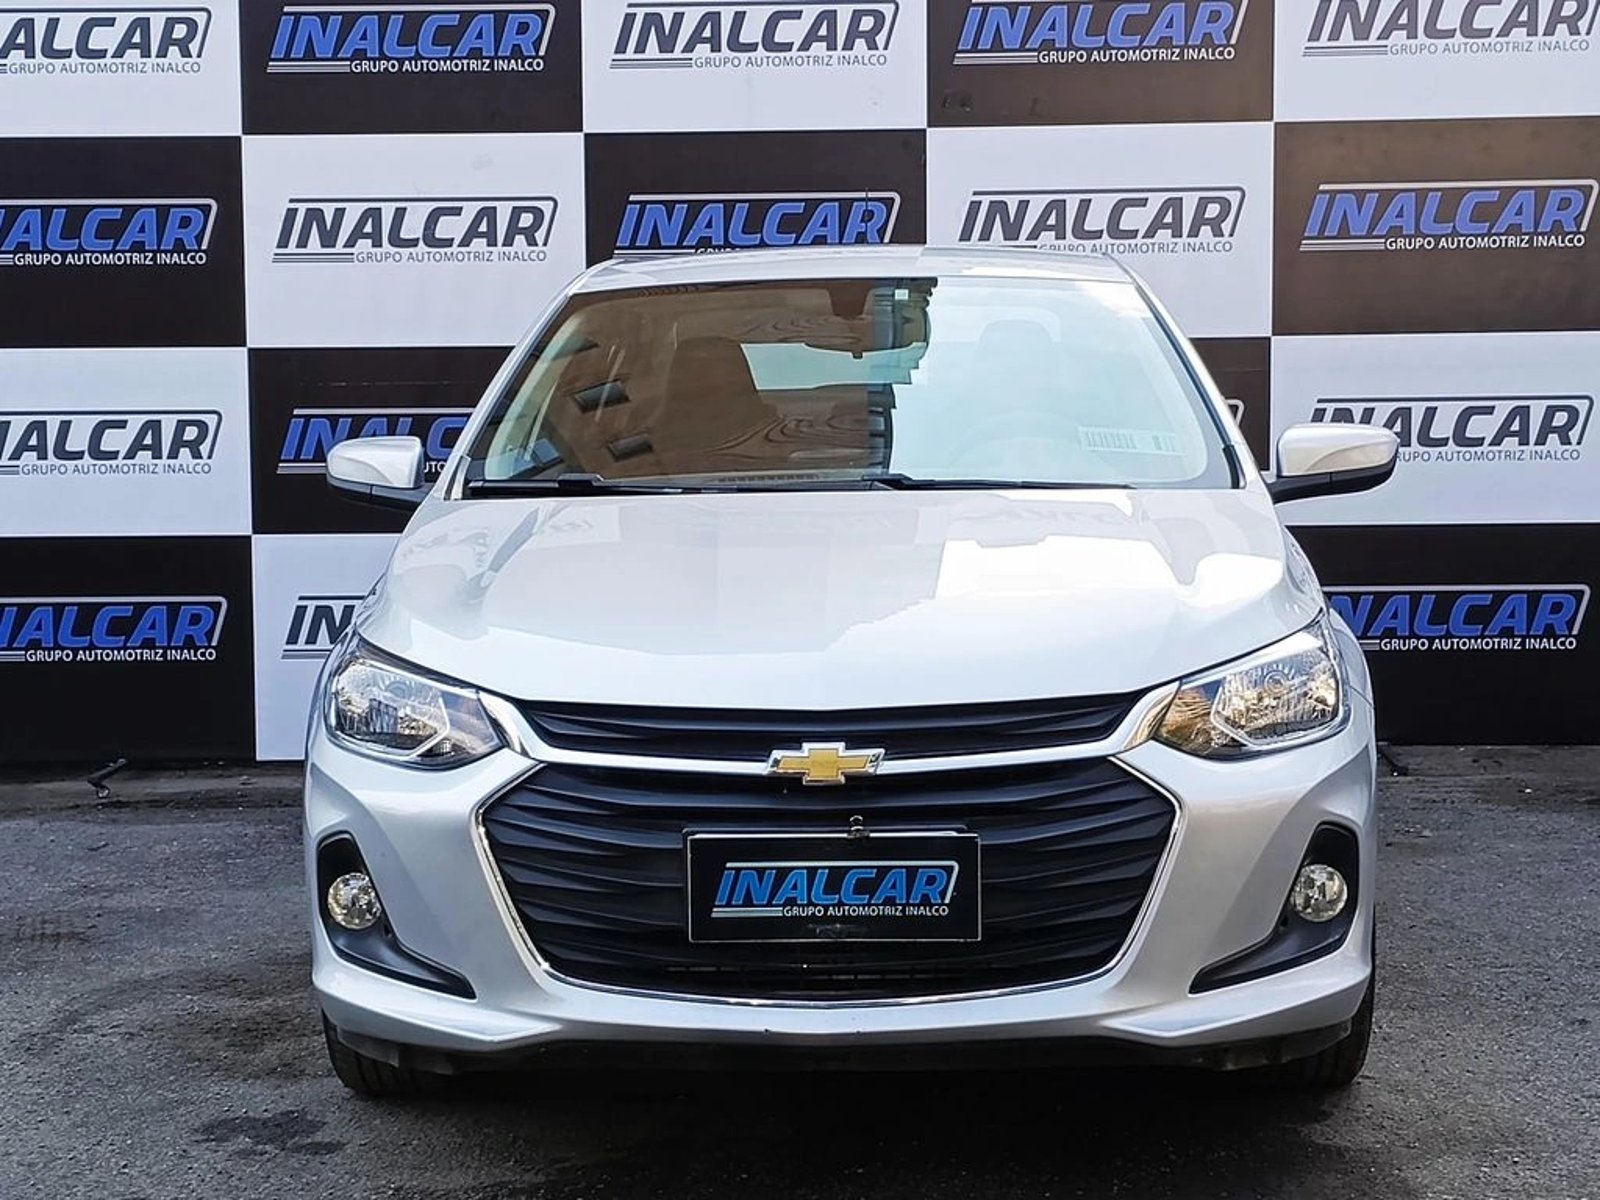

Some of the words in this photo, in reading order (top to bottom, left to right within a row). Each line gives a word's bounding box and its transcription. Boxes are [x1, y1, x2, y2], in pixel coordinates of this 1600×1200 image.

[958, 2, 1234, 50] INALCAR
[1307, 0, 1588, 42] INALCAR
[270, 13, 542, 58] INALCAR
[614, 9, 886, 54] INALCAR
[1038, 51, 1087, 64] GRUPO
[1090, 49, 1180, 62] AUTOMOTRIZ
[1183, 47, 1235, 60] INALCO
[1390, 43, 1437, 55] GRUPO
[1442, 41, 1532, 54] AUTOMOTRIZ
[1537, 40, 1590, 52] INALCO
[9, 62, 55, 74] GRUPO
[60, 62, 147, 74] AUTOMOTRIZ
[151, 62, 201, 73] INALCO
[351, 60, 398, 73] GRUPO
[402, 59, 490, 72] AUTOMOTRIZ
[494, 58, 544, 71] INALCO
[694, 56, 741, 68] GRUPO
[745, 55, 833, 67] AUTOMOTRIZ
[837, 54, 887, 66] INALCO
[959, 196, 1232, 242] INALCAR
[1304, 189, 1585, 237] INALCAR
[0, 207, 204, 250] ALCAR
[276, 206, 545, 249] INALCAR
[616, 201, 887, 247] INALCAR
[1091, 242, 1179, 254] AUTOMOTRIZ
[1182, 241, 1233, 253] INALCO
[1385, 238, 1435, 250] GRUPO
[1439, 236, 1529, 249] AUTOMOTRIZ
[1533, 234, 1585, 247] INALCO
[14, 253, 62, 266] GRUPO
[65, 253, 153, 265] AUTOMOTRIZ
[157, 252, 207, 265] INALCO
[356, 251, 402, 263] GRUPO
[407, 250, 494, 263] AUTOMOTRIZ
[498, 250, 547, 262] INALCO
[0, 419, 209, 461] ALCAR
[1435, 450, 1525, 462] AUTOMOTRIZ
[1529, 449, 1580, 461] INALCO
[21, 464, 68, 475] GRUPO
[72, 464, 159, 475] AUTOMOTRIZ
[163, 463, 211, 474] INALCO
[1381, 638, 1429, 651] GRUPO
[1433, 638, 1521, 650] AUTOMOTRIZ
[1525, 637, 1576, 649] INALCO
[26, 650, 73, 662] GRUPO
[76, 649, 164, 661] AUTOMOTRIZ
[167, 648, 217, 661] INALCO
[714, 868, 948, 905] INALCAR
[783, 906, 824, 917] GRUPO
[827, 905, 903, 917] AUTOMOTRIZ
[905, 905, 949, 916] INALCO
